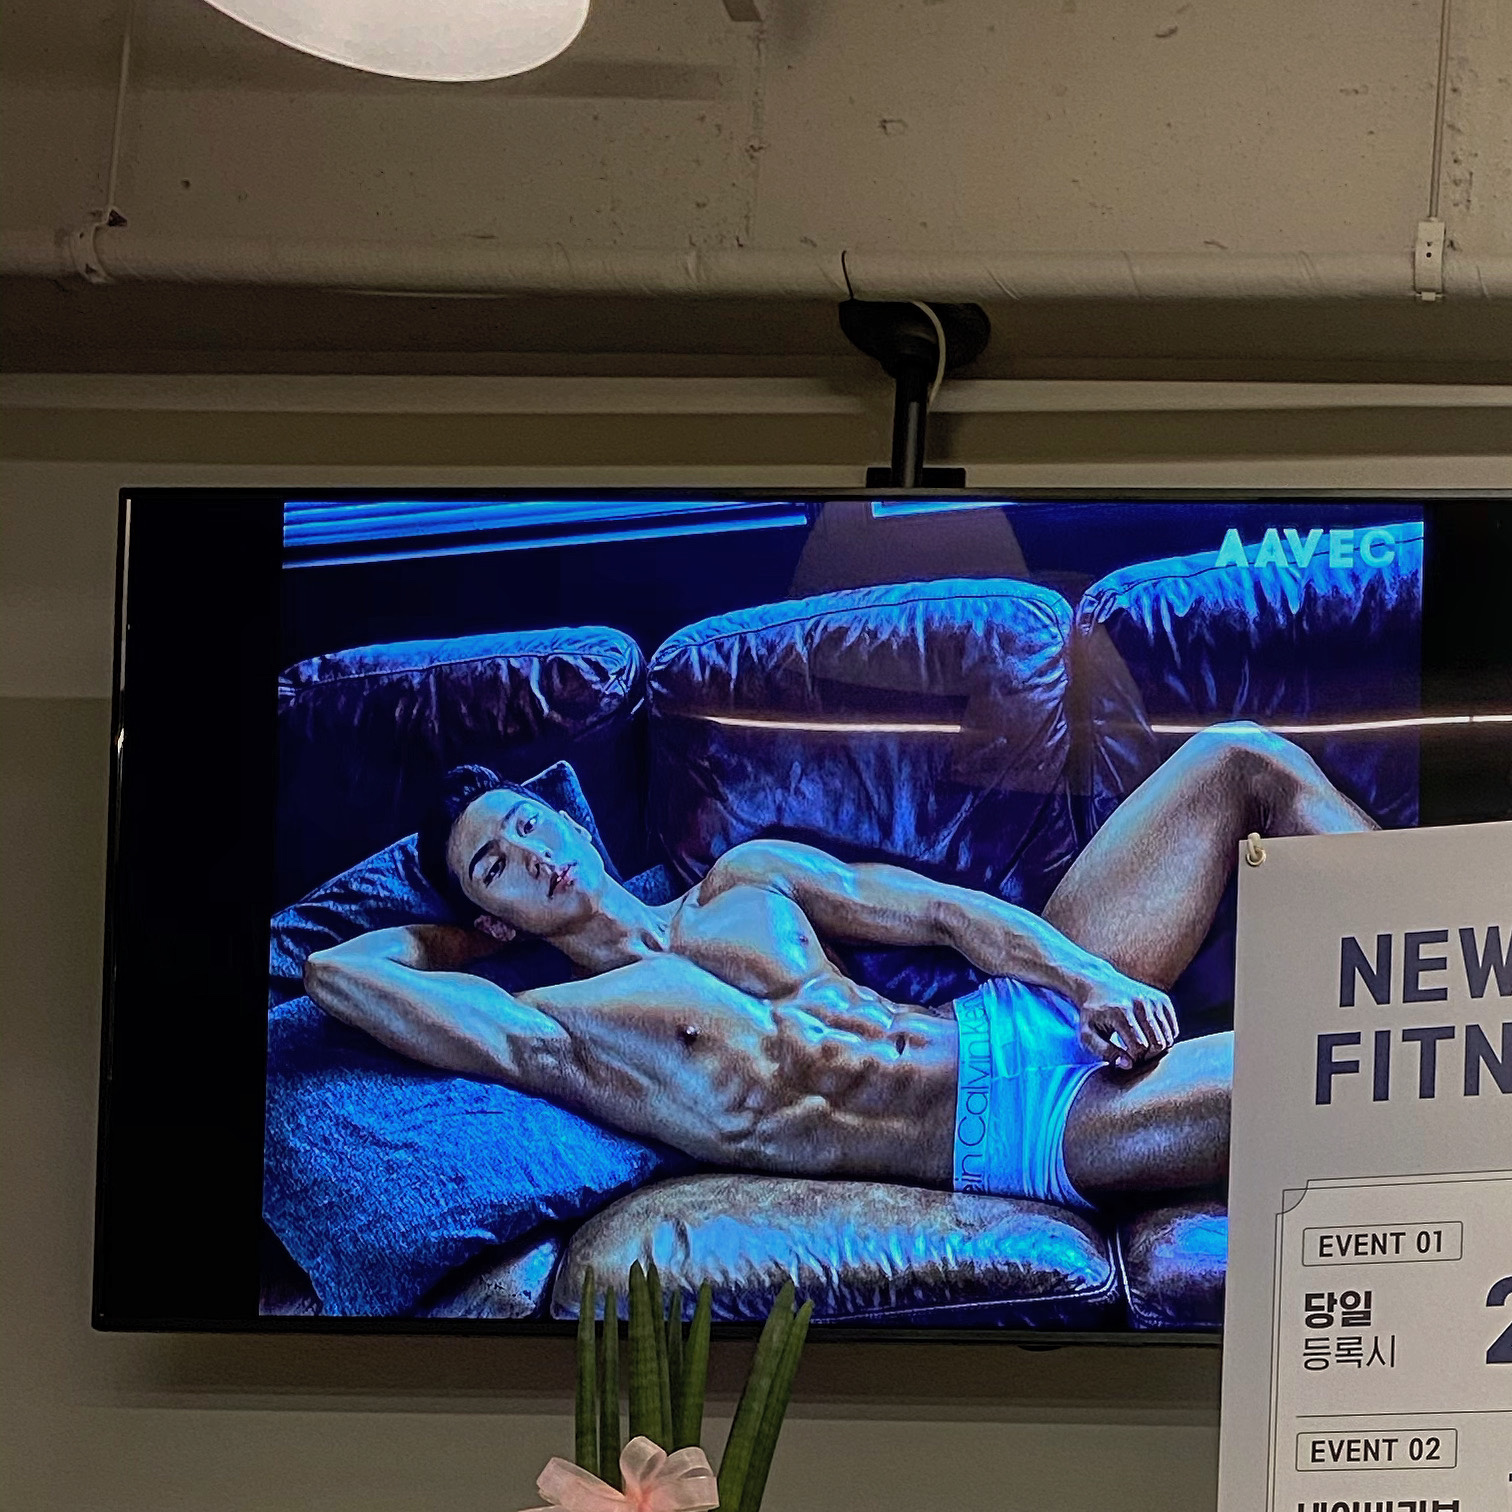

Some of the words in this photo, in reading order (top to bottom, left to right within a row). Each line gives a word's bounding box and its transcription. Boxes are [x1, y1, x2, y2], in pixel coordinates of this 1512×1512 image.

[1215, 528, 1396, 568] AAVEC
[957, 1040, 990, 1147] Calvin
[1318, 1232, 1406, 1258] EVENT
[1416, 1230, 1442, 1254] 01
[1305, 1291, 1372, 1328] 당일
[1303, 1335, 1395, 1370] 등록시
[1311, 1439, 1398, 1463] EVENT
[1410, 1437, 1440, 1460] 02
